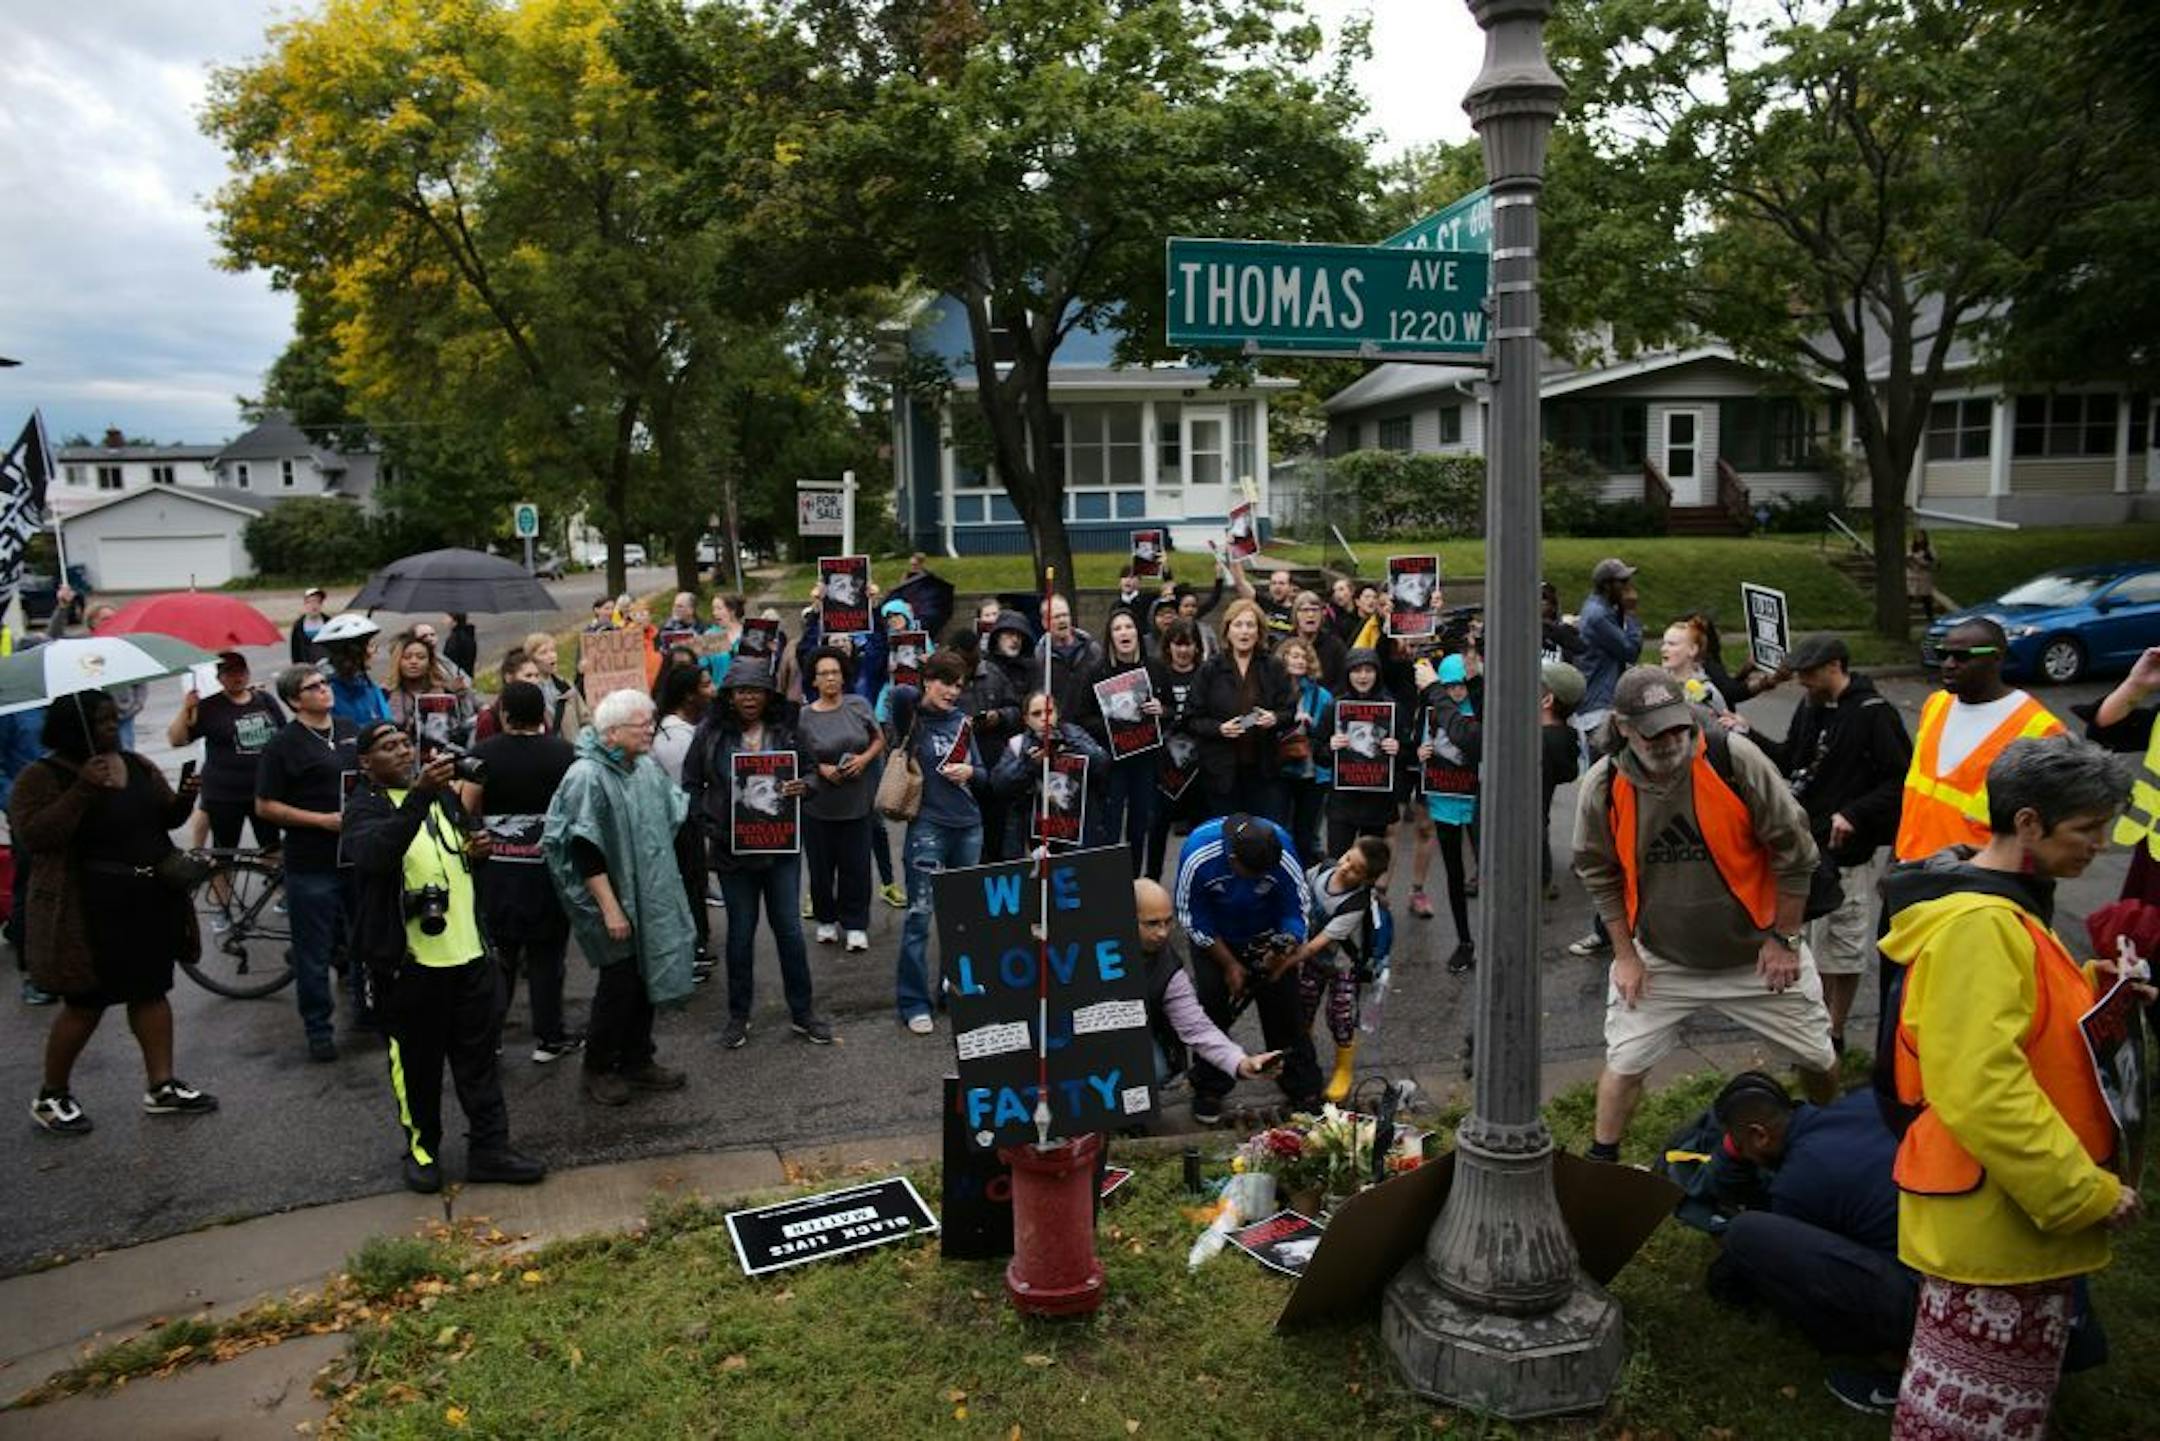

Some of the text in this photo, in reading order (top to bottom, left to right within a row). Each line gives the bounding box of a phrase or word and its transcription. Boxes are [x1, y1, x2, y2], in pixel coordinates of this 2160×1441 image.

[1406, 259, 1459, 291] AVE
[1178, 262, 1365, 329] THOMAS
[1389, 310, 1483, 342] 1220 W
[816, 495, 838, 508] FOR
[816, 508, 843, 520] SALE
[584, 632, 641, 656] POLICE
[594, 654, 637, 673] KILL
[983, 866, 1081, 917] WE
[957, 939, 1126, 996] LOVE
[768, 1215, 910, 1257] BLACK LIVES
